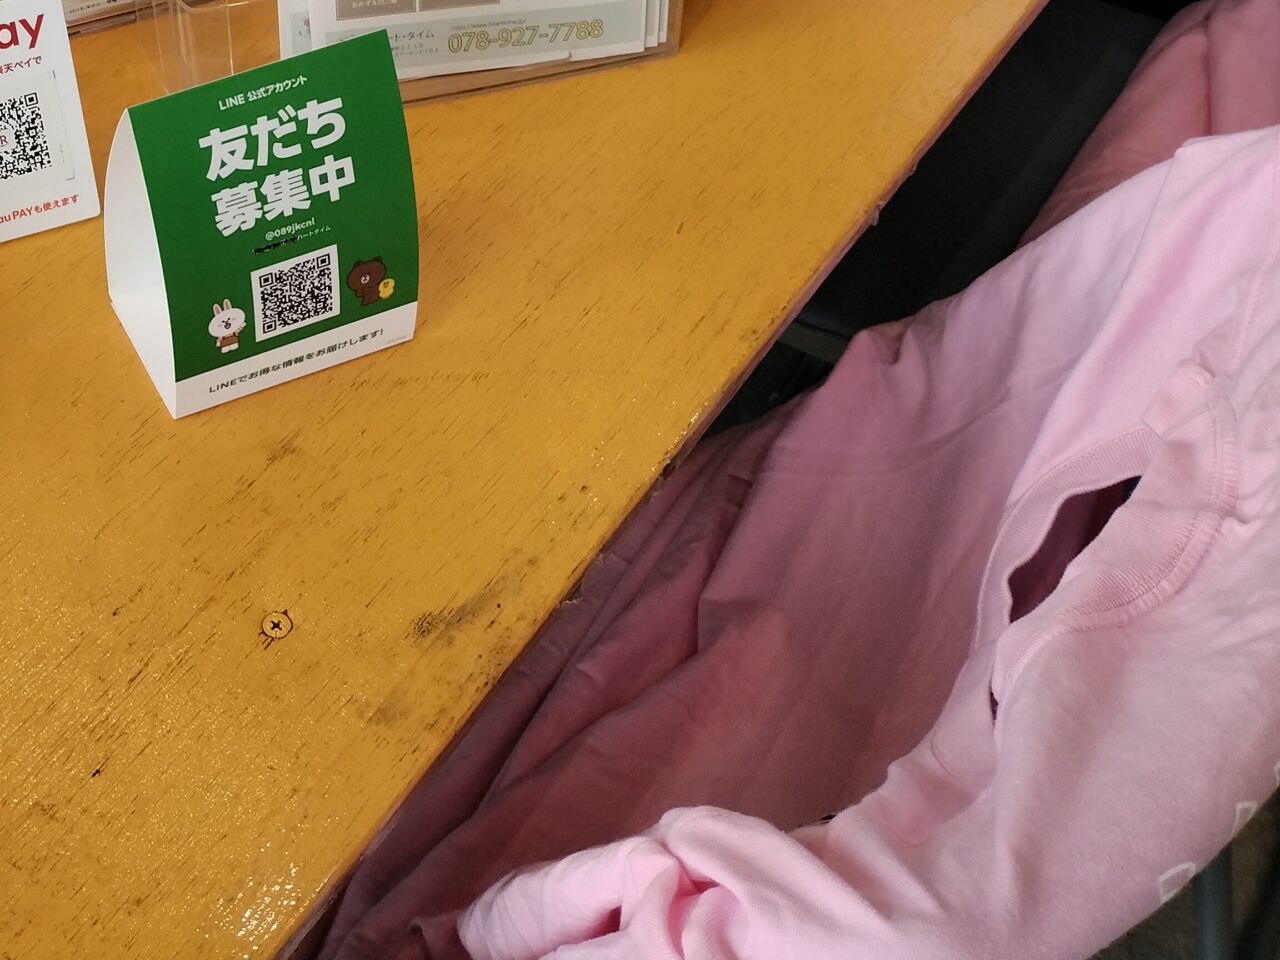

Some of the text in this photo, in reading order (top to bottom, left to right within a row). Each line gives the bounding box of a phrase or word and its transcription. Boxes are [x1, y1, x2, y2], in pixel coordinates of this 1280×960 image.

[448, 19, 604, 54] 078-927-7788
[218, 74, 308, 111] LINE 公式アカウント
[198, 96, 347, 182] 友だち
[211, 155, 356, 237] 募集中
[209, 328, 385, 394] LINEでお得な情報をお届けします!
